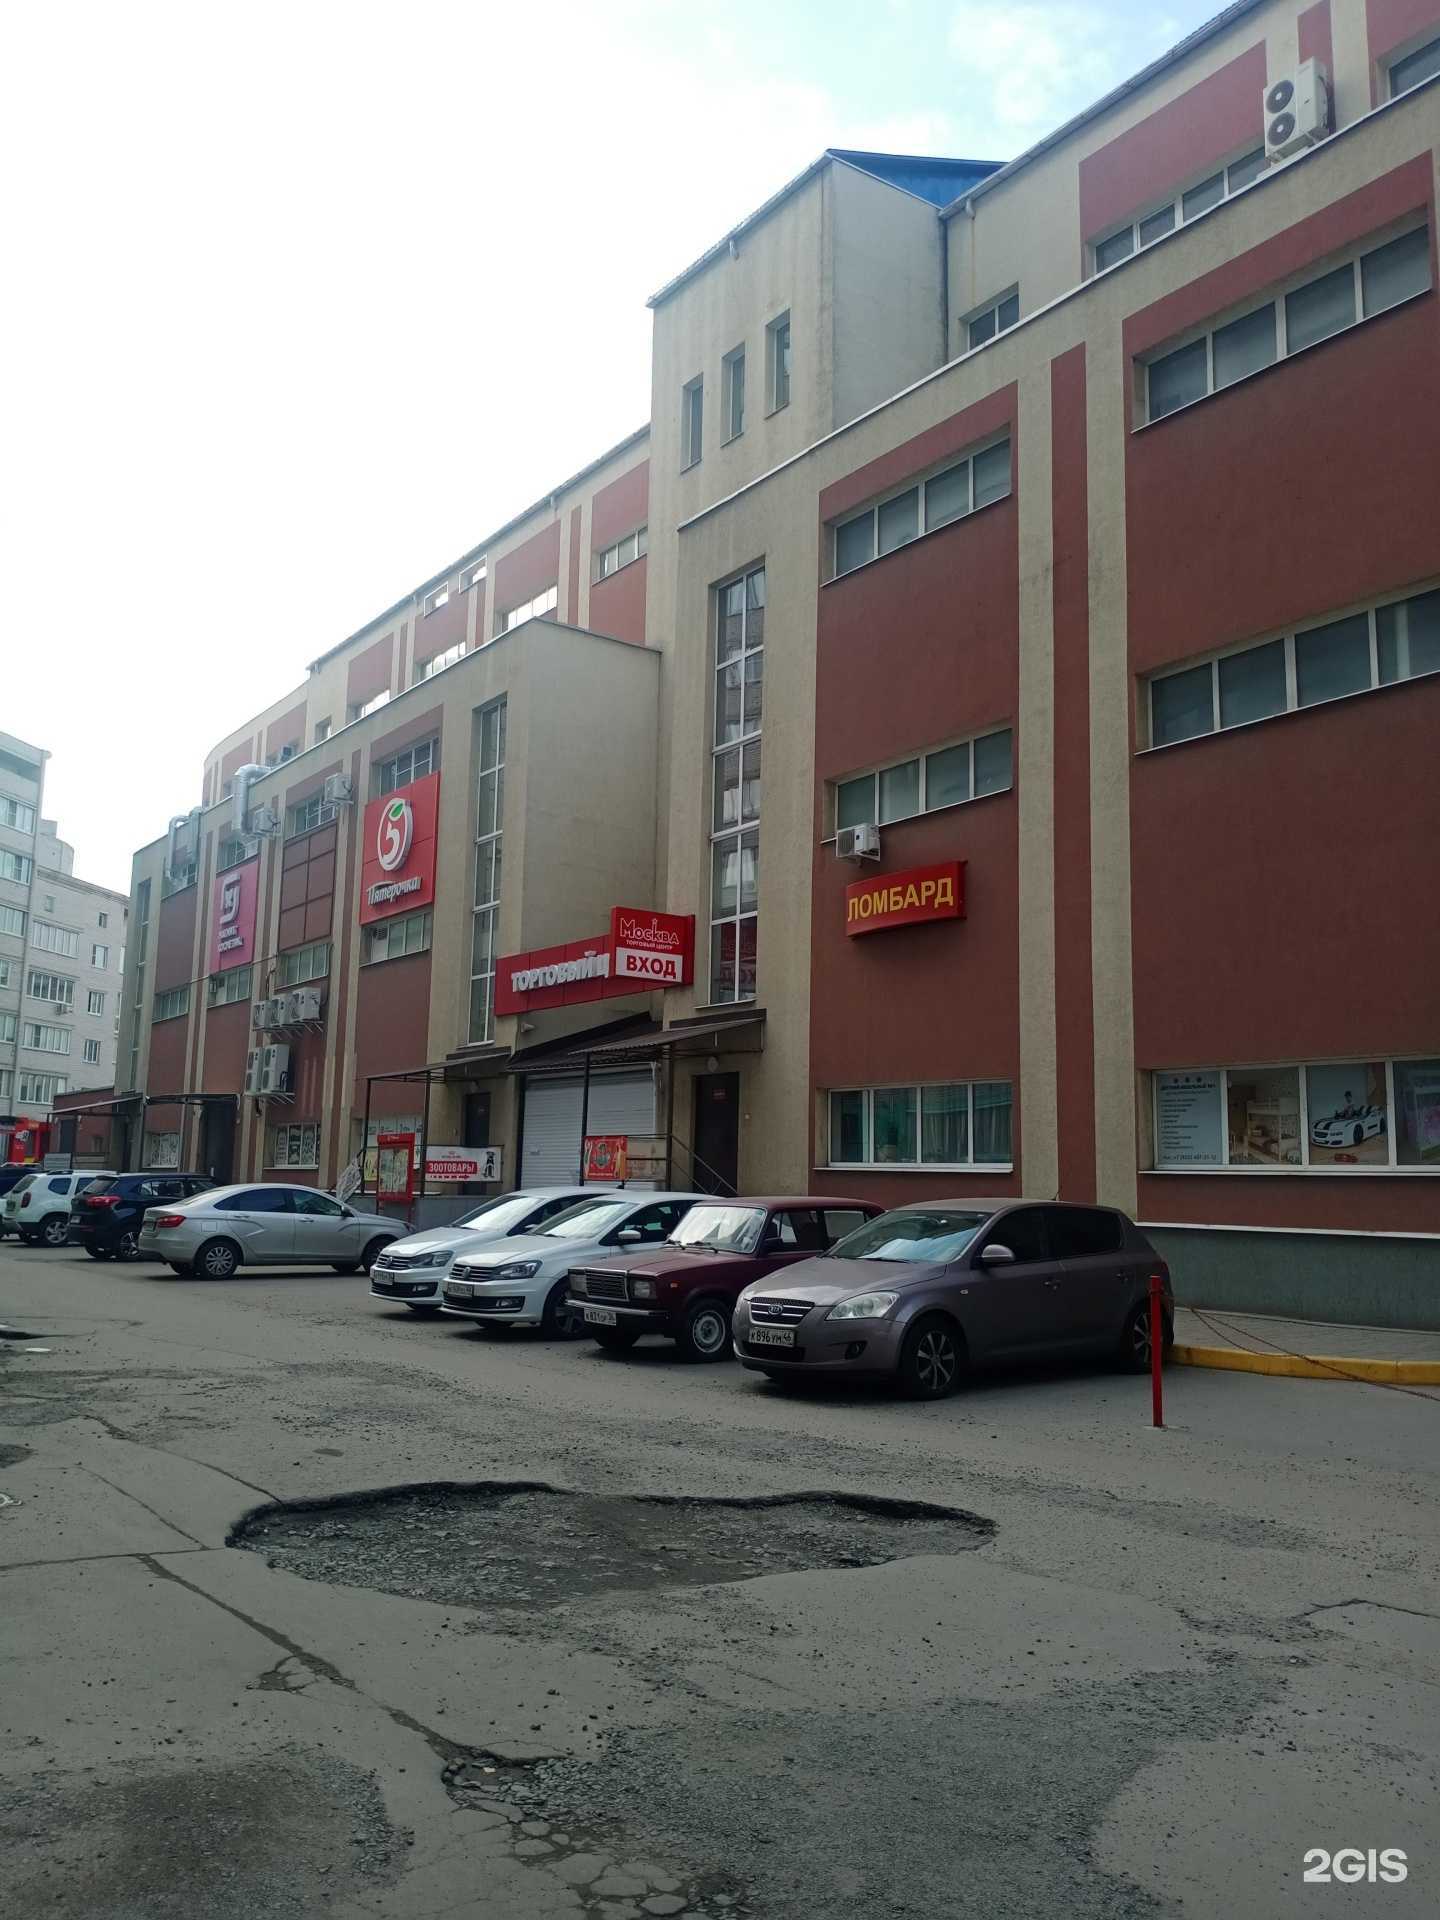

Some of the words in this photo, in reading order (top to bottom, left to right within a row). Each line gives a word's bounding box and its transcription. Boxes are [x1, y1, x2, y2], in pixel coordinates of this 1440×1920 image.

[847, 877, 954, 922] ЛОМБАРД
[626, 939, 656, 948] ТОРГОВЫЙ
[511, 950, 598, 993] ТОРГОВЫЙ
[626, 954, 677, 980] ВХОД
[429, 1162, 475, 1172] ЗООТОВАРЫ
